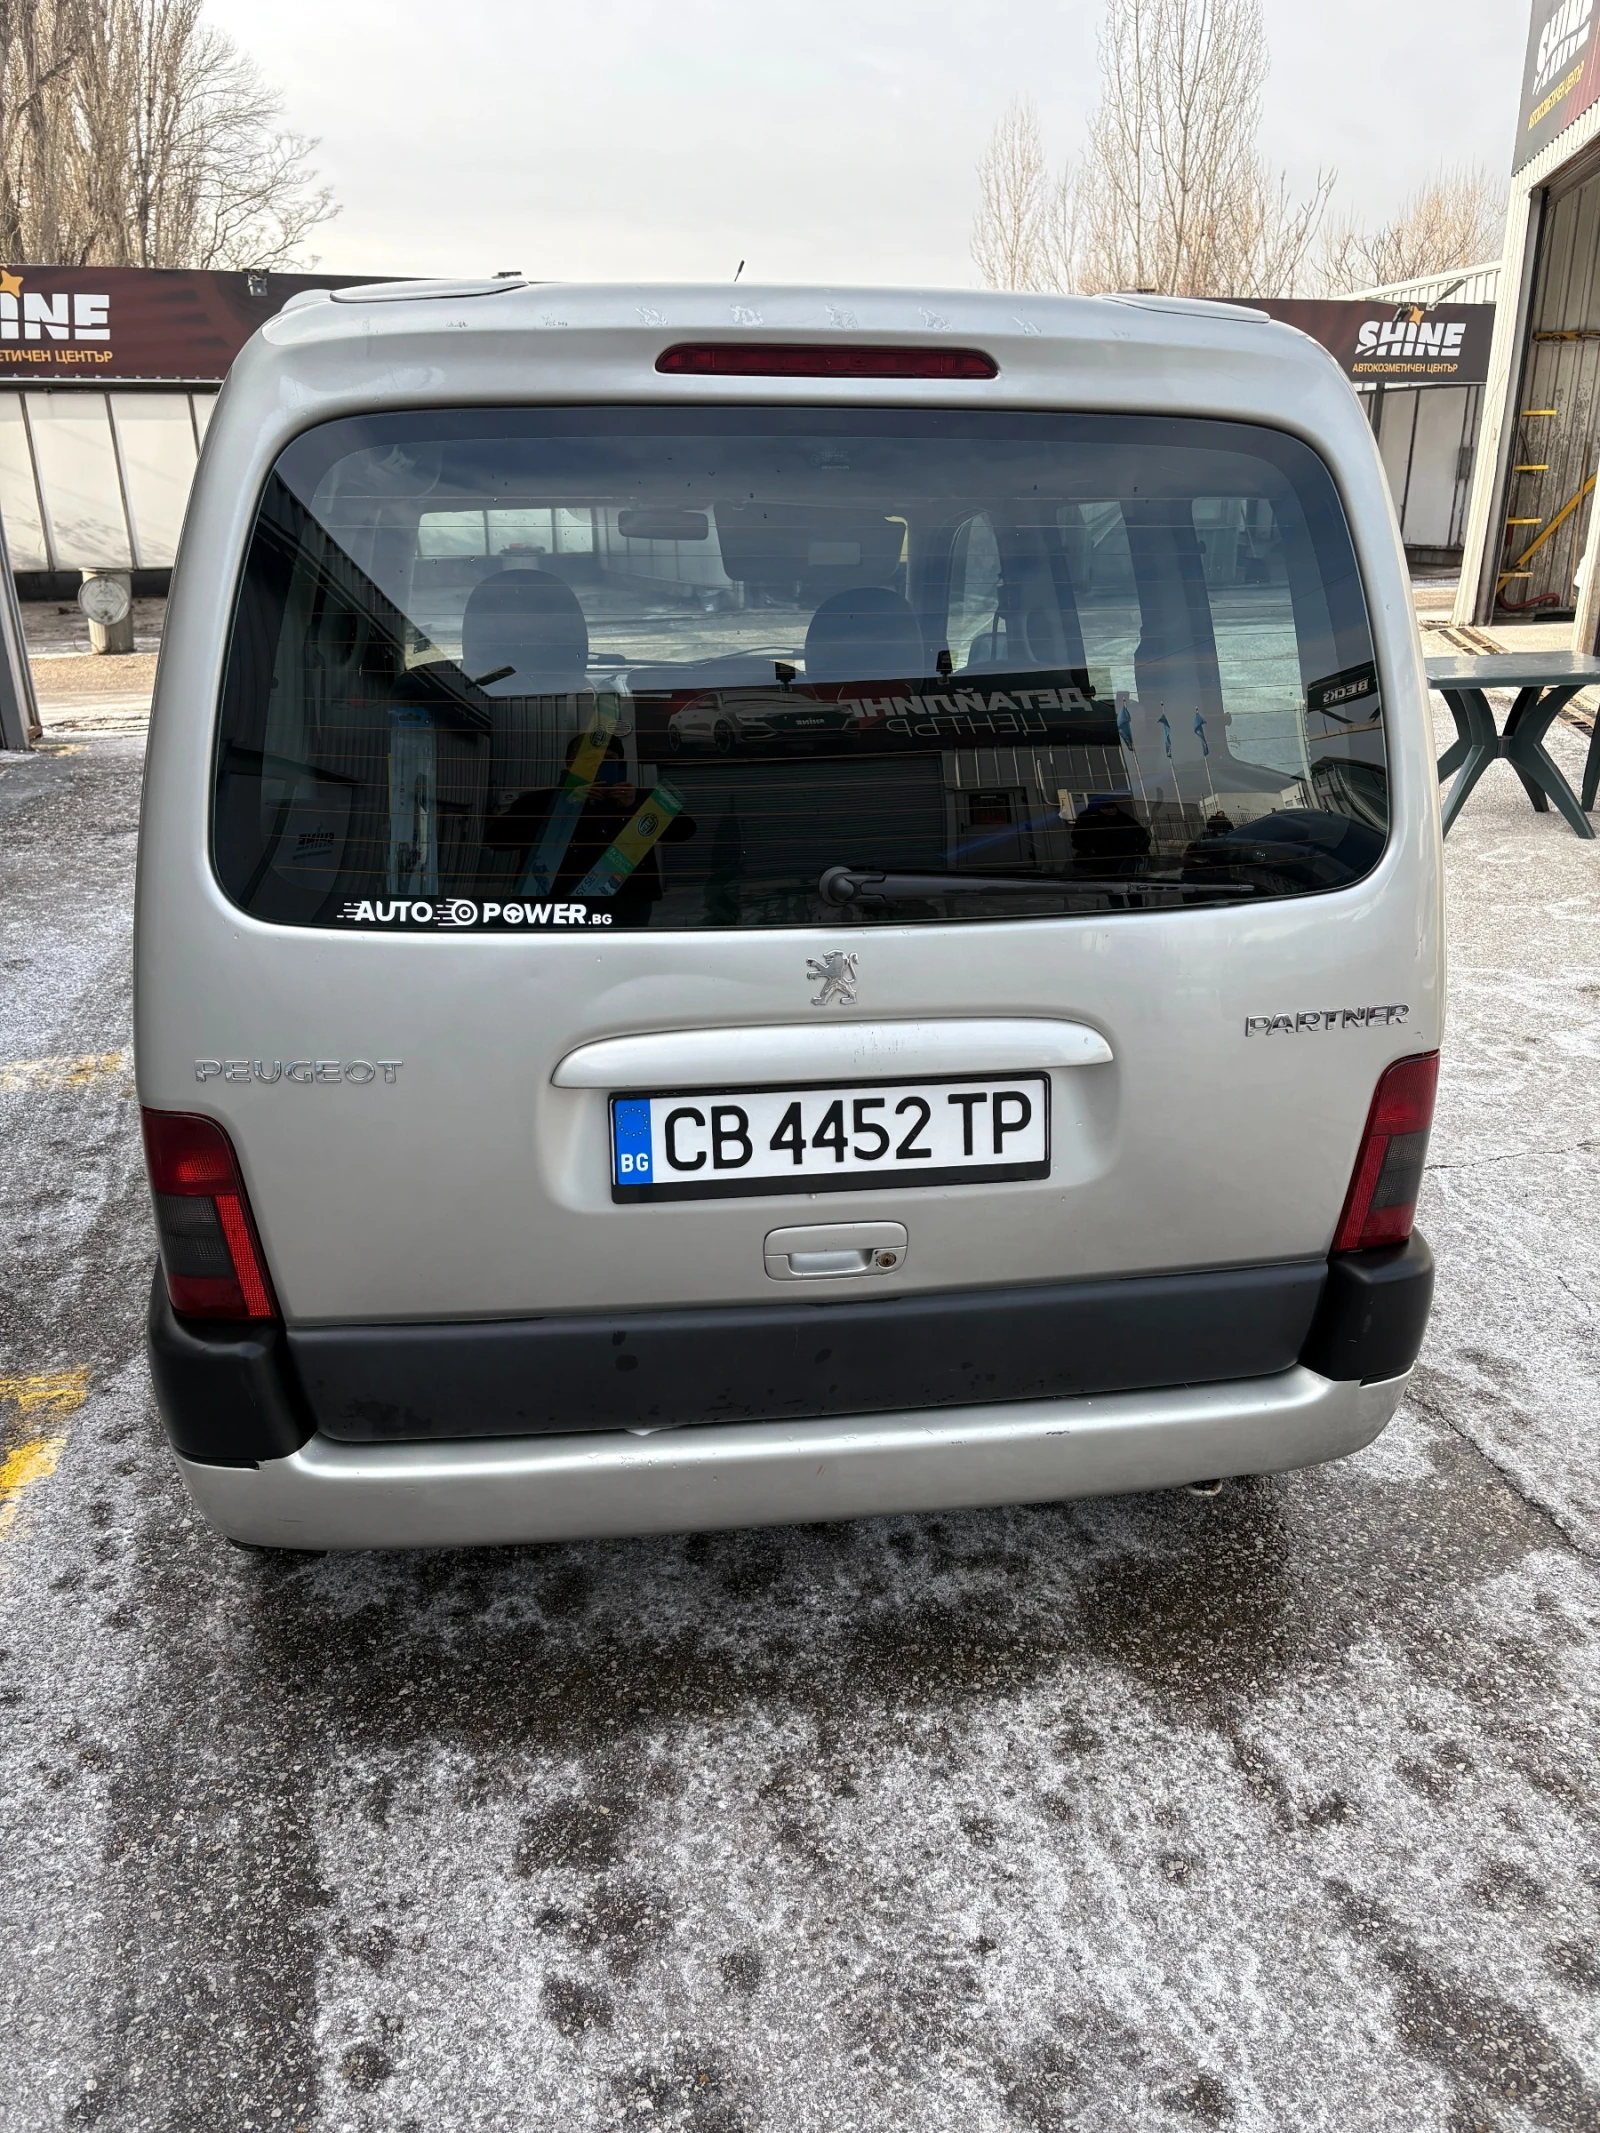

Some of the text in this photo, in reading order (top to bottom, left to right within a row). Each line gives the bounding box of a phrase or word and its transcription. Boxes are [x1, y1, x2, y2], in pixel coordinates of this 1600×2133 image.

[1355, 321, 1466, 356] SHINE
[54, 350, 113, 364] ЦЕНТЪР
[1352, 363, 1458, 374] АВТОКОЗМЕТИЧЕН ЦЕНТЪР
[353, 900, 434, 922] AUTO
[1245, 1003, 1410, 1037] PARTNER
[194, 1058, 404, 1084] PEUGEOT
[664, 1090, 1032, 1171] CB 4452 TP
[620, 1153, 649, 1174] BG
